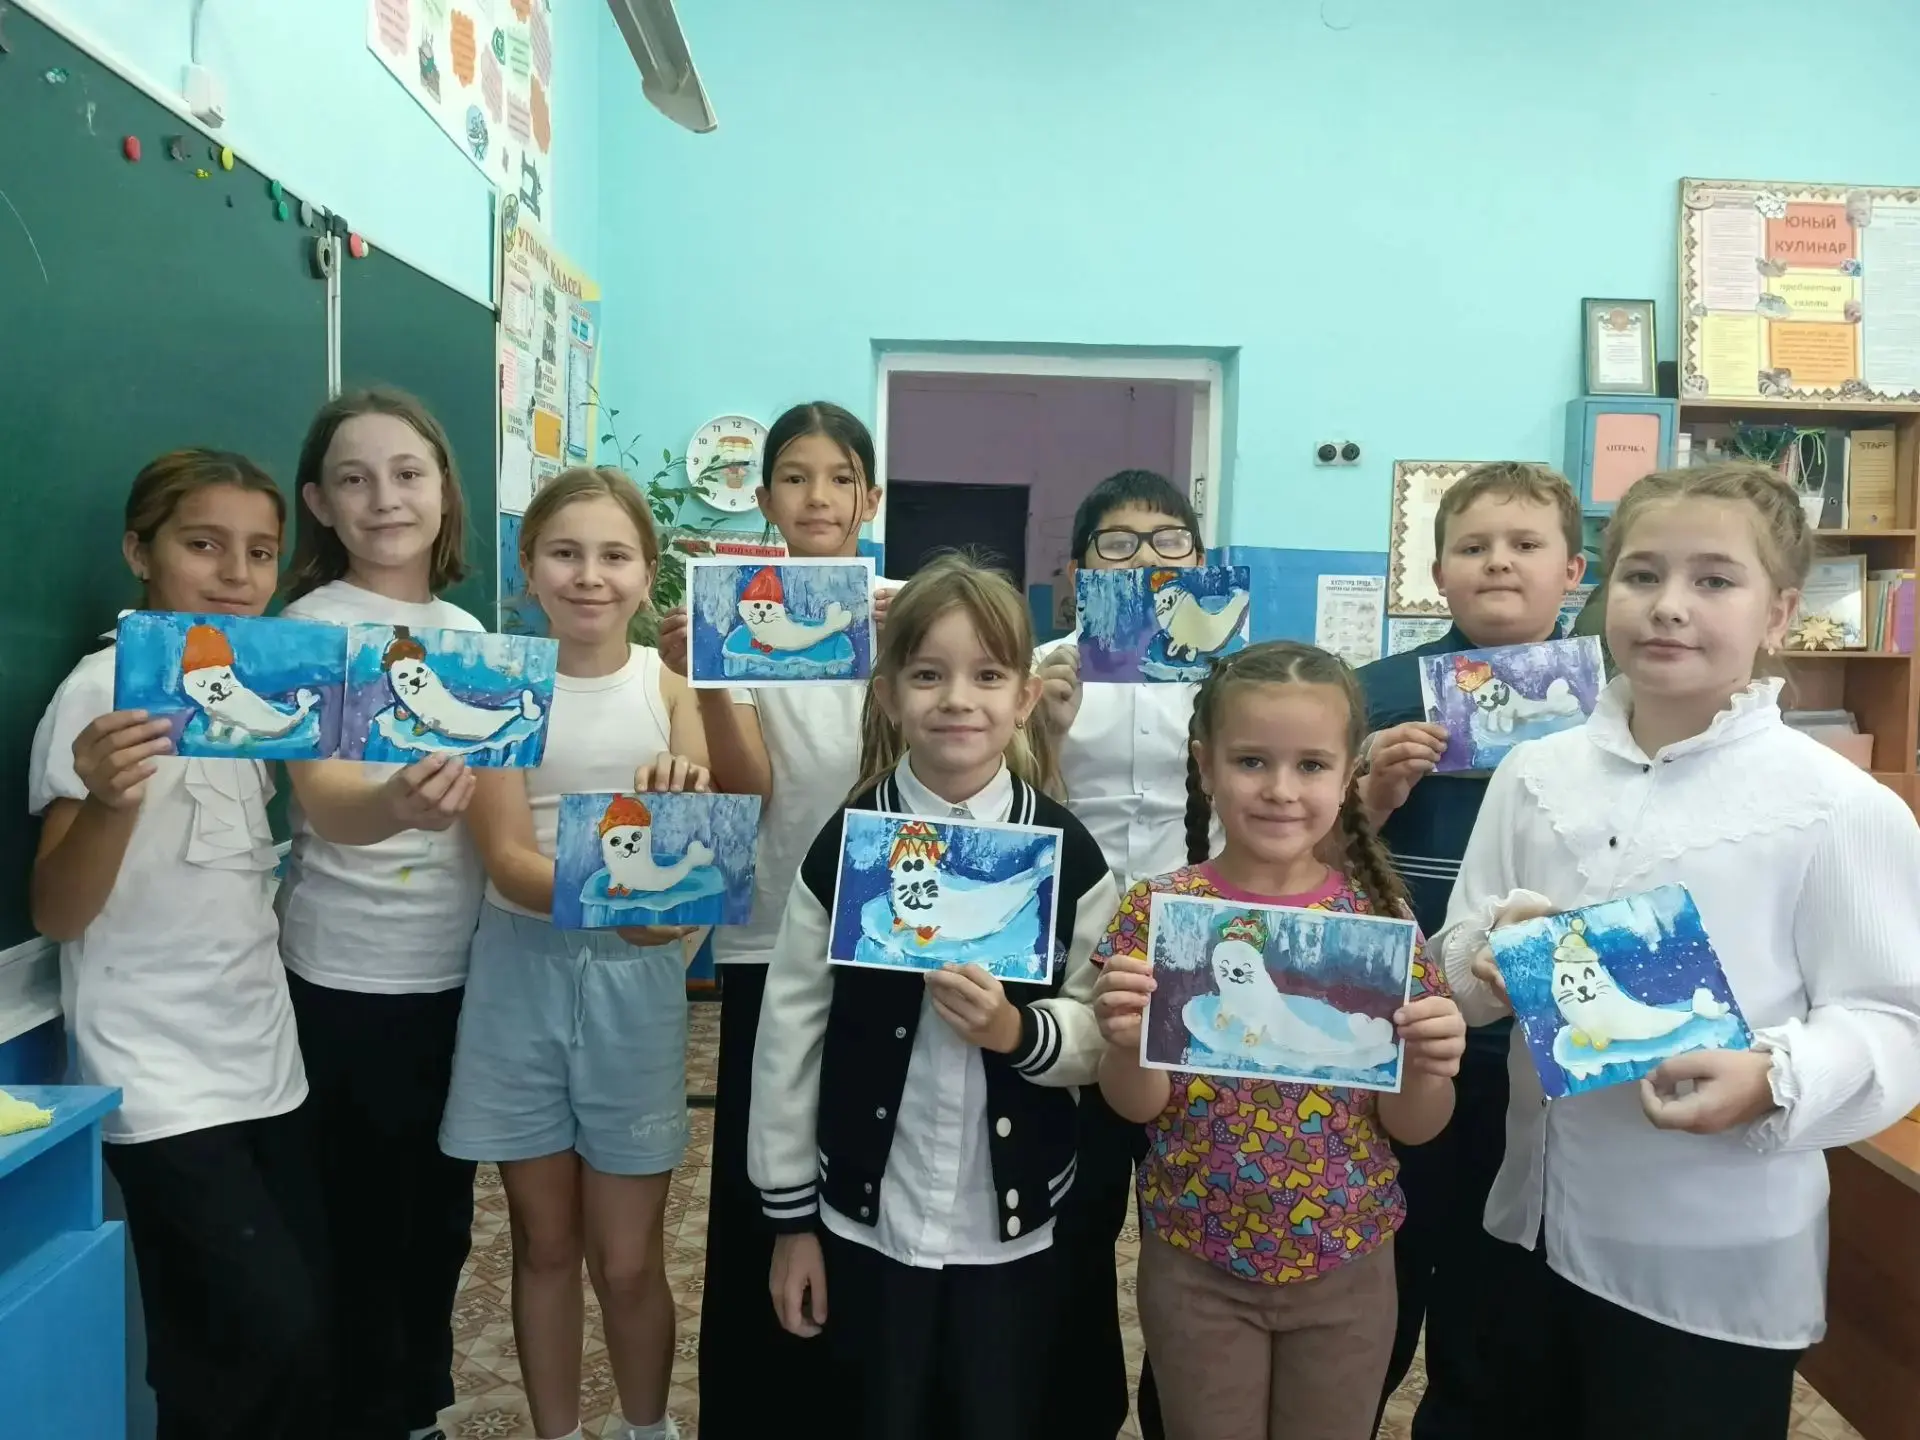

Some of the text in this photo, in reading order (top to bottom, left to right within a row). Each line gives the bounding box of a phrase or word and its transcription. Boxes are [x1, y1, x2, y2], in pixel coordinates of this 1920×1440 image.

[1785, 214, 1837, 229] ЮНЫЙ
[1774, 240, 1847, 255] КУЛИНАР
[518, 227, 548, 272] УГОЛОК
[550, 259, 582, 299] КЛАССА
[731, 421, 742, 429] 12
[1606, 444, 1647, 453] АПТЕЧКА
[1858, 441, 1889, 450] STAFF
[693, 457, 699, 465] 9
[711, 492, 717, 500] 7
